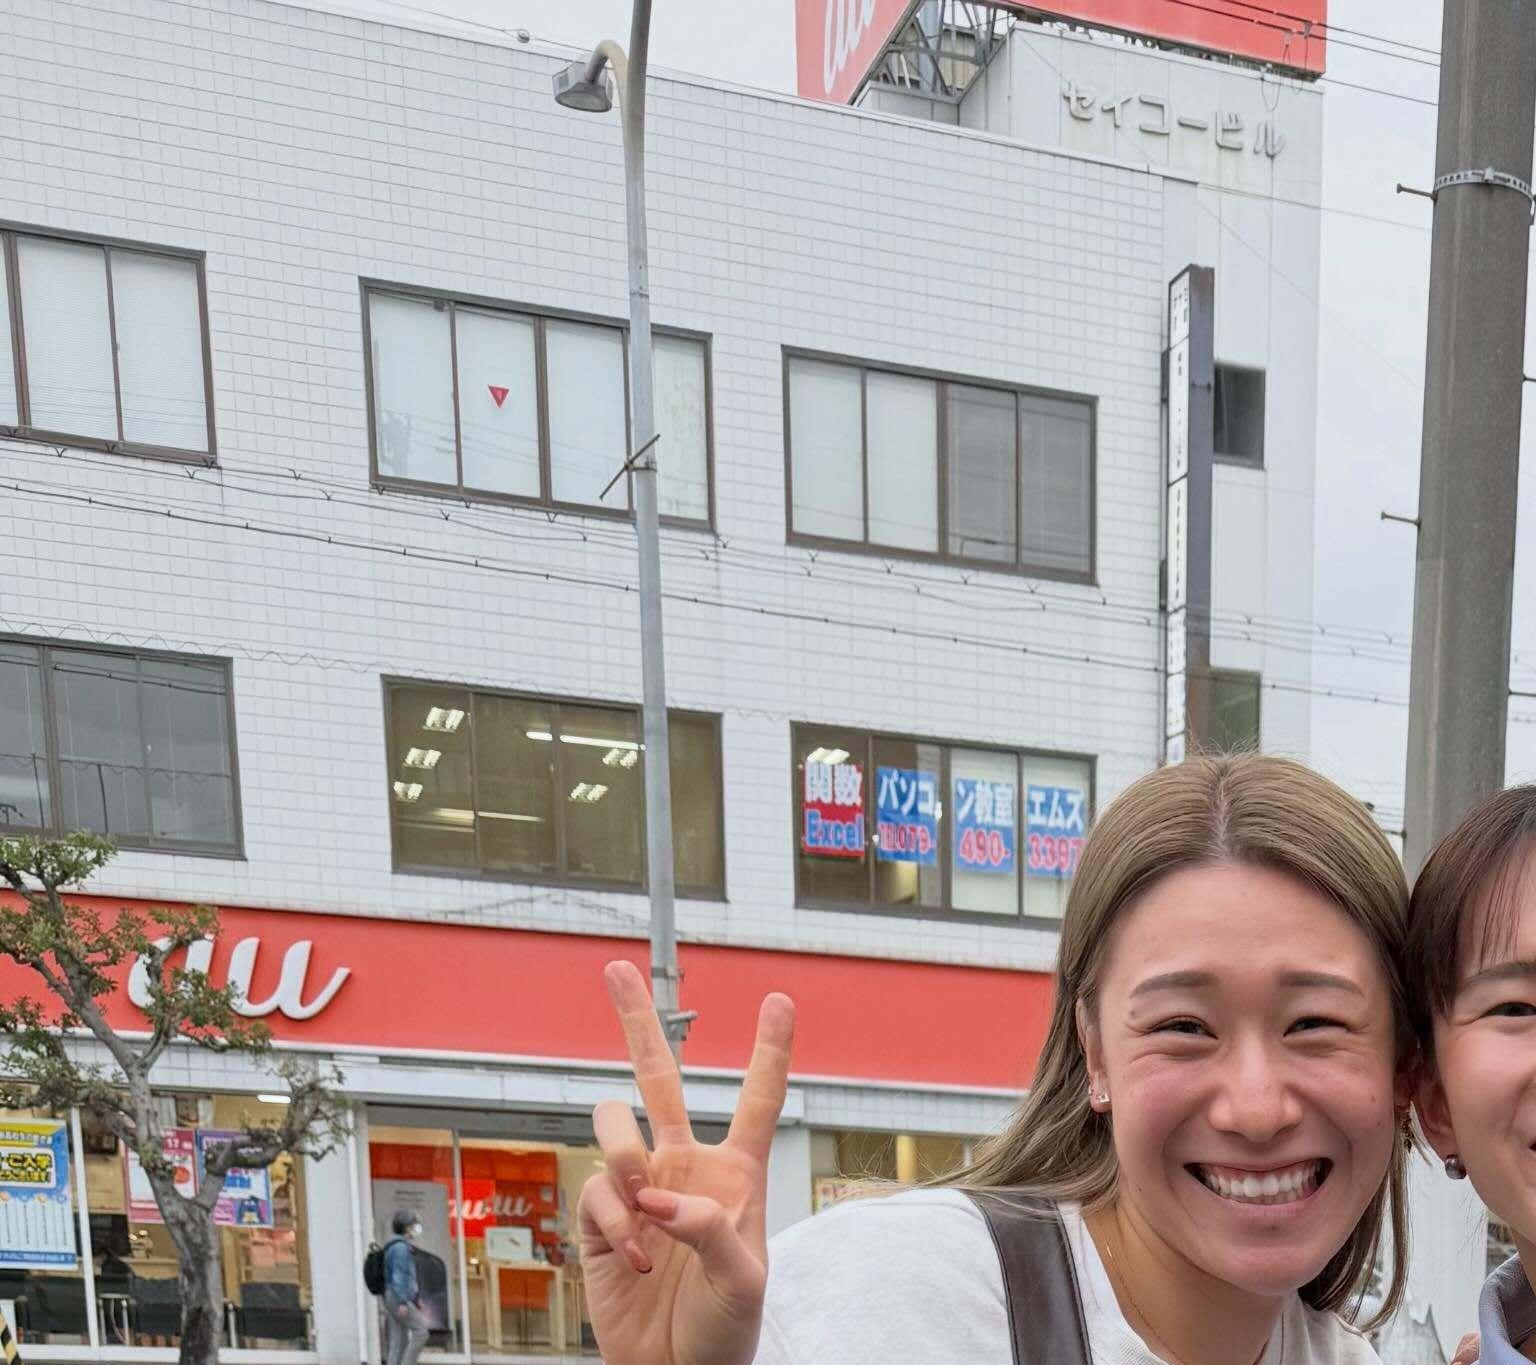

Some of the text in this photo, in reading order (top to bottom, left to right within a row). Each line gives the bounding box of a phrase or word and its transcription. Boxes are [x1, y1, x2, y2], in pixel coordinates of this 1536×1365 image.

[1062, 80, 1287, 158] セイコービル
[805, 808, 864, 851] Excel
[128, 933, 351, 1020] au
